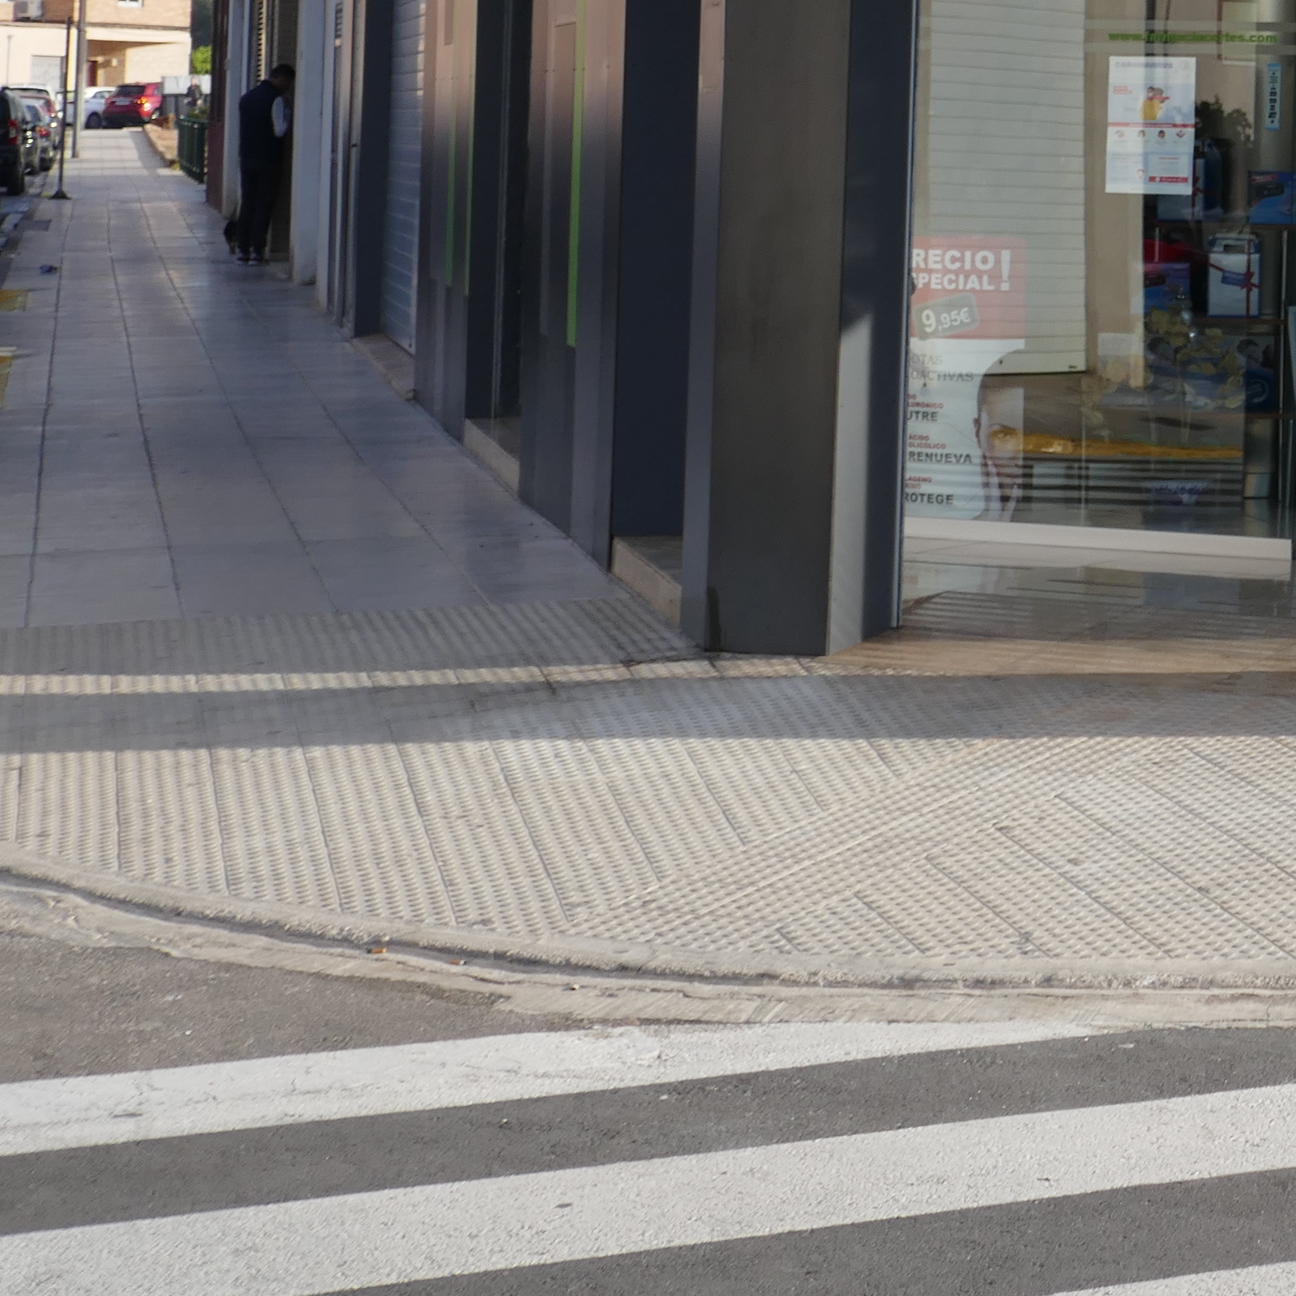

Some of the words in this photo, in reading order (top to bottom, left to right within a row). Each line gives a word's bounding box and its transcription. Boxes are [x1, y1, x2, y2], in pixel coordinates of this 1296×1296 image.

[911, 249, 995, 271] RECIO
[910, 273, 995, 291] SPECIAL
[921, 306, 971, 333] 9,95€
[911, 354, 943, 365] OTAS
[908, 452, 973, 464] RENUEVA
[904, 492, 954, 505] ROTEGE
